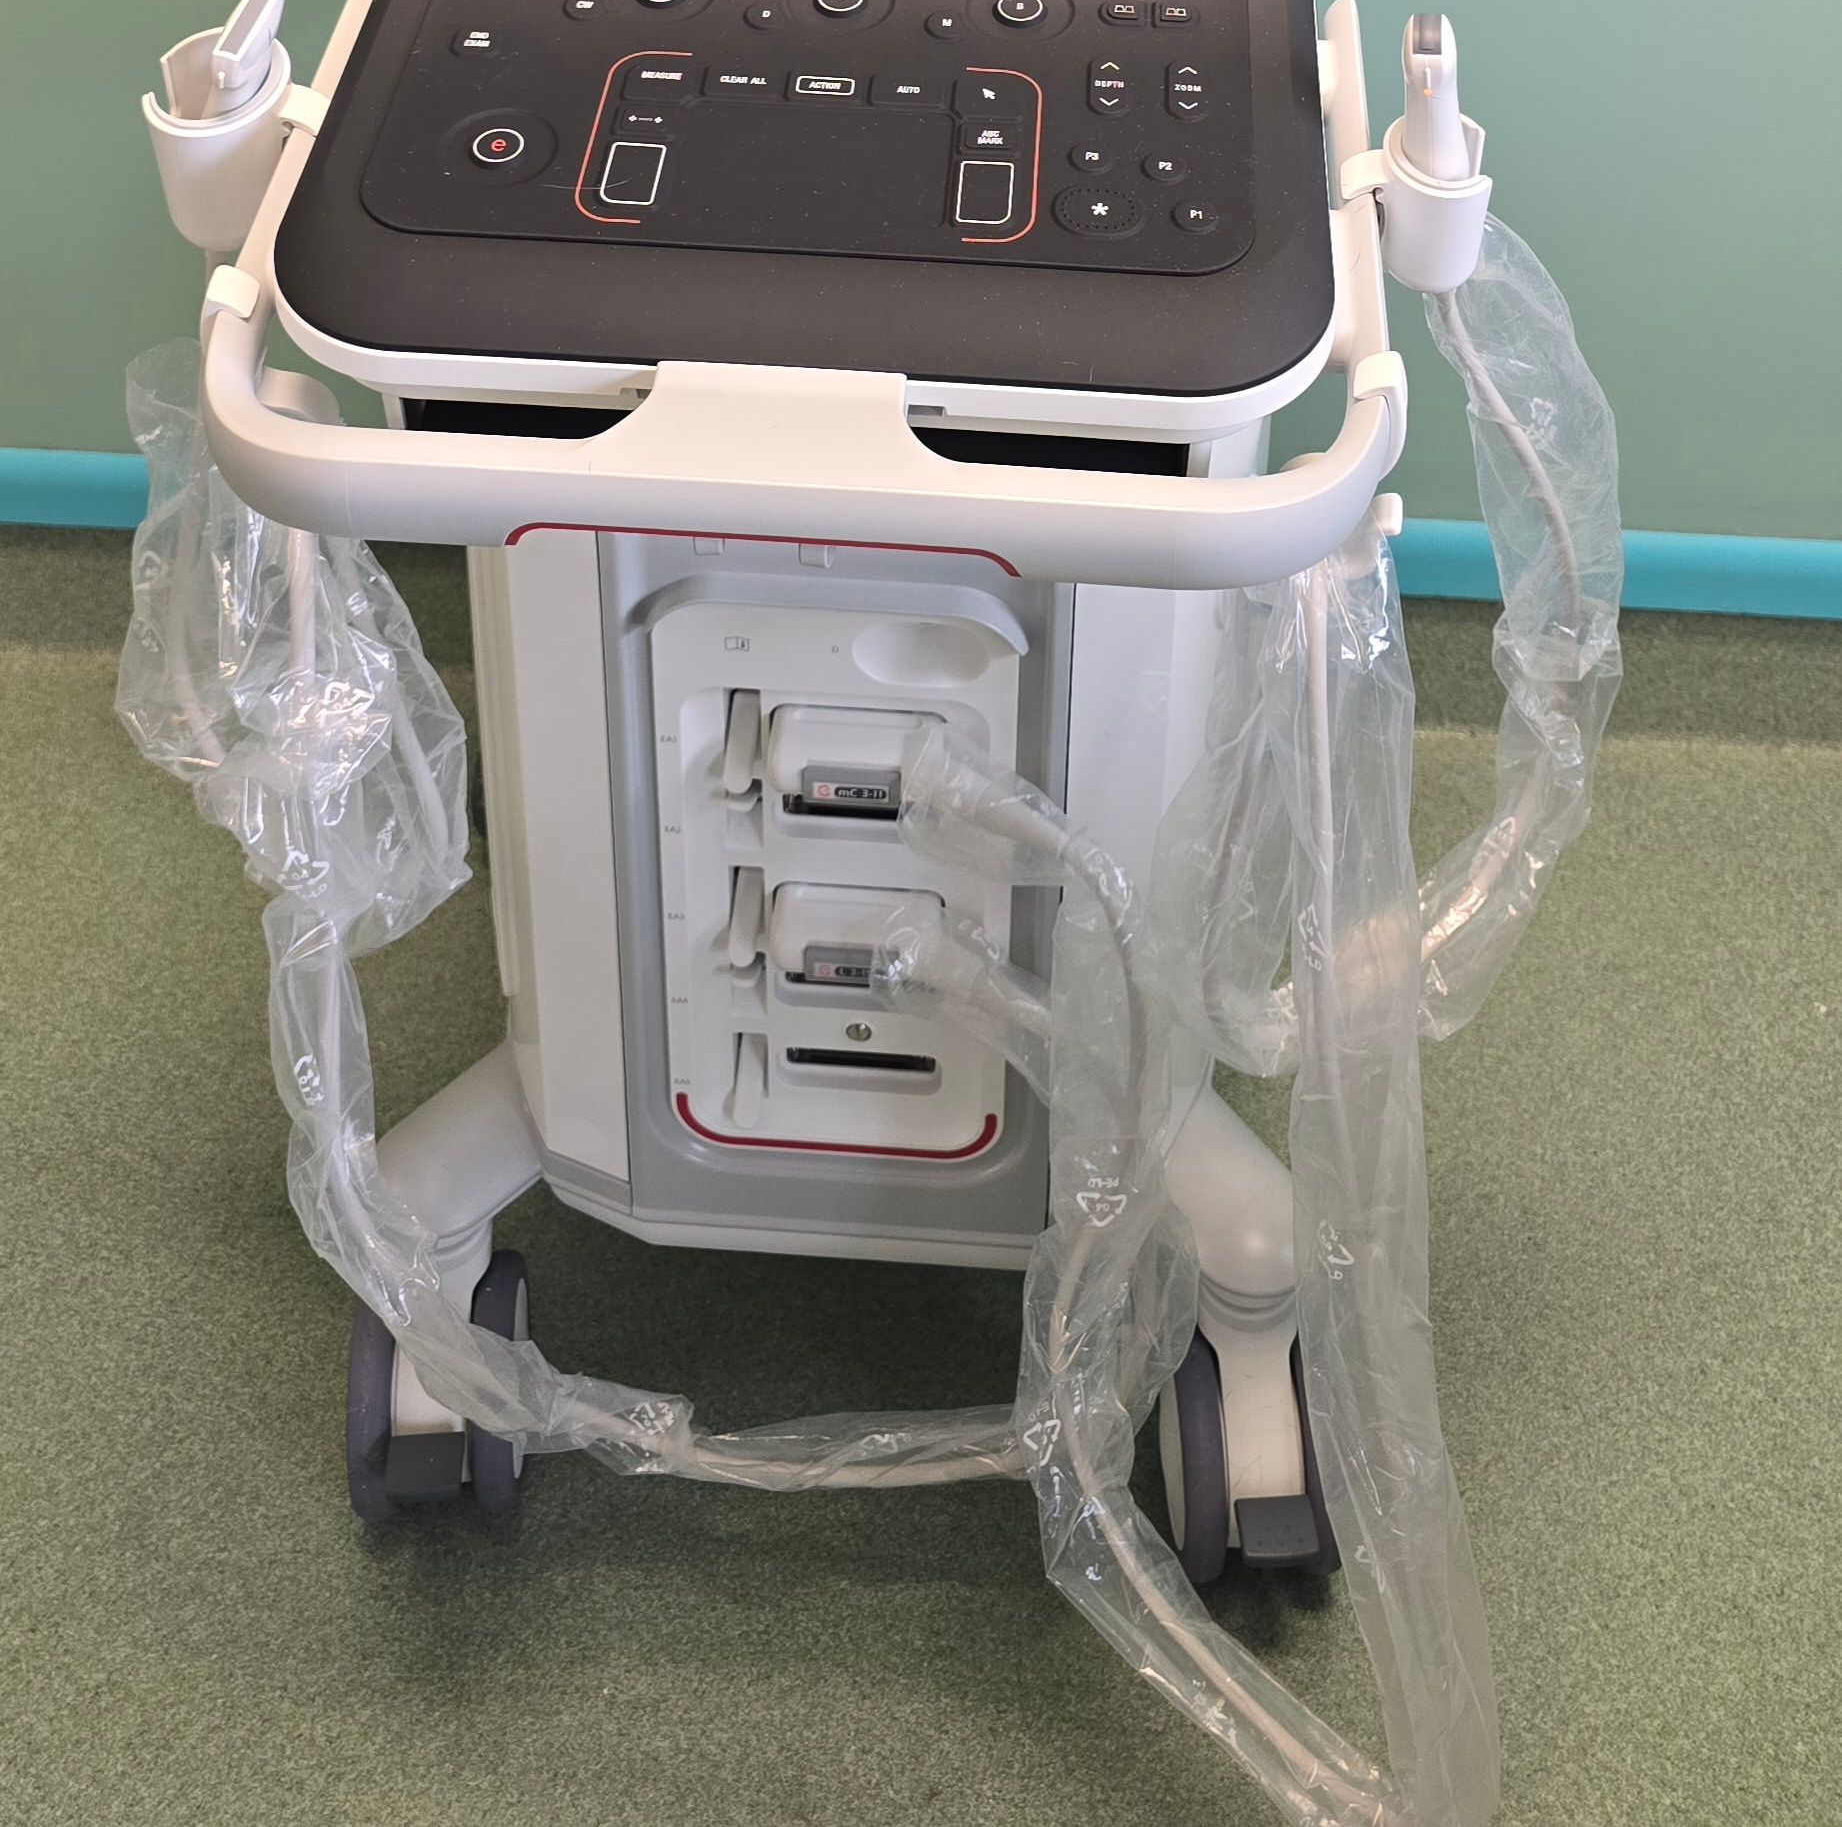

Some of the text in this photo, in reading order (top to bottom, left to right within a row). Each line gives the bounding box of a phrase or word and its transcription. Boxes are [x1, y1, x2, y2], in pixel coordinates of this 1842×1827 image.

[576, 0, 594, 10] CW
[1016, 2, 1024, 11] B
[762, 10, 771, 19] D
[942, 18, 952, 27] M
[641, 70, 683, 81] MEASURE
[720, 75, 767, 85] CLEAR ALL
[808, 81, 842, 90] ACTION
[1094, 79, 1125, 89] DEPTH
[1174, 84, 1202, 93] ZOOM
[897, 85, 921, 94] AUTO
[977, 136, 1004, 145] MARK
[1085, 151, 1100, 161] P3
[1158, 161, 1173, 171] P2
[1190, 209, 1203, 220] P1
[838, 788, 858, 797] mC
